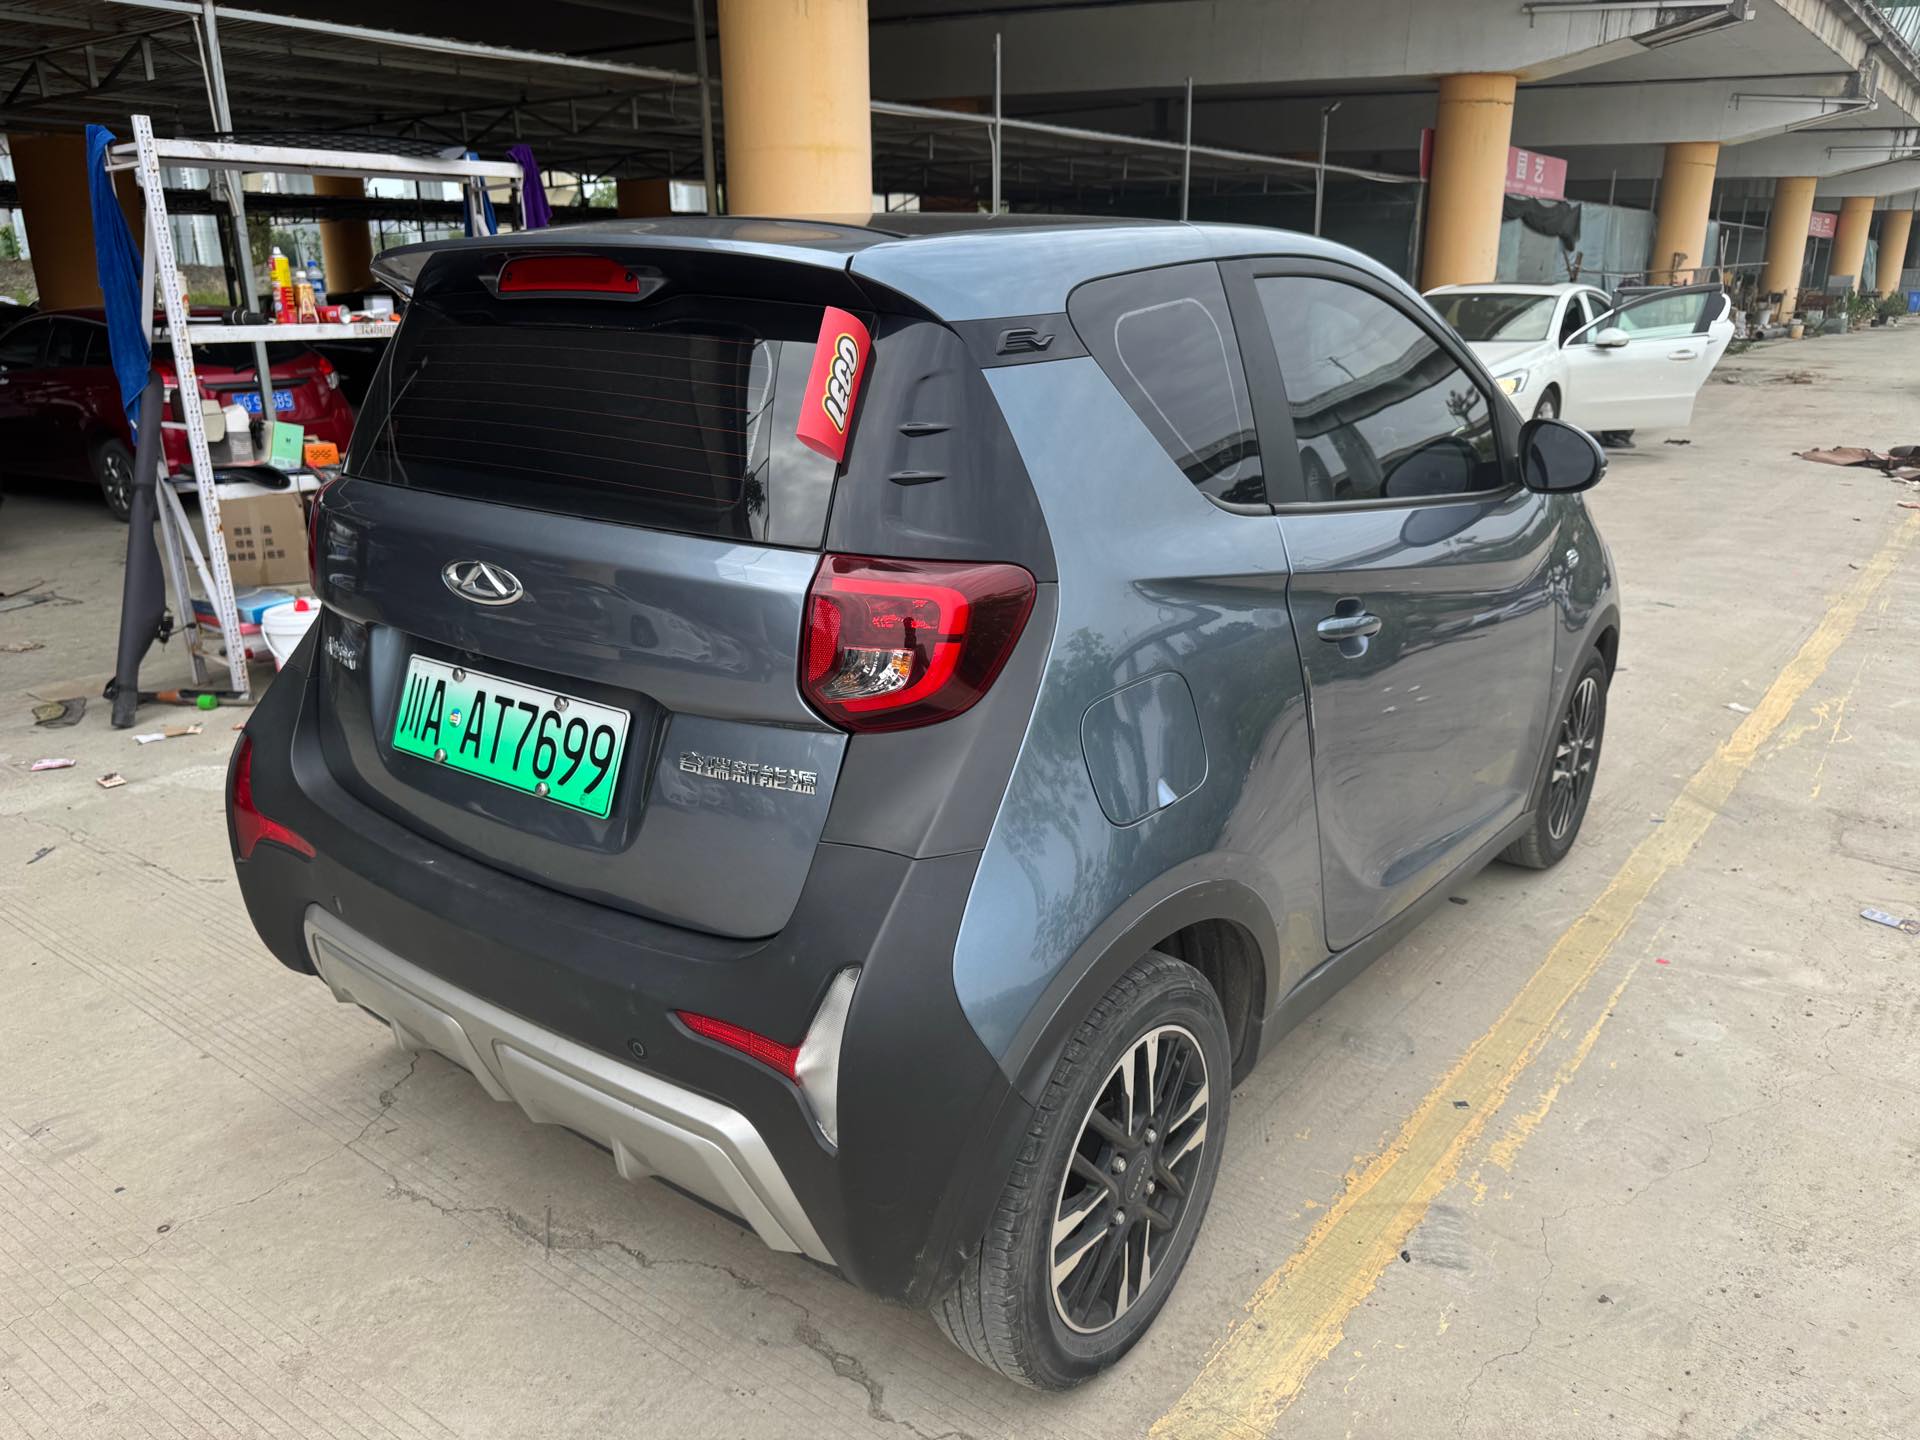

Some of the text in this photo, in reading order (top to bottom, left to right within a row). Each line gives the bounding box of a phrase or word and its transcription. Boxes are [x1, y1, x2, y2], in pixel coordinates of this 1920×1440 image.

[823, 334, 859, 433] LEGO
[459, 690, 616, 795] AT7699
[679, 751, 818, 796] 奇瑞新能源
